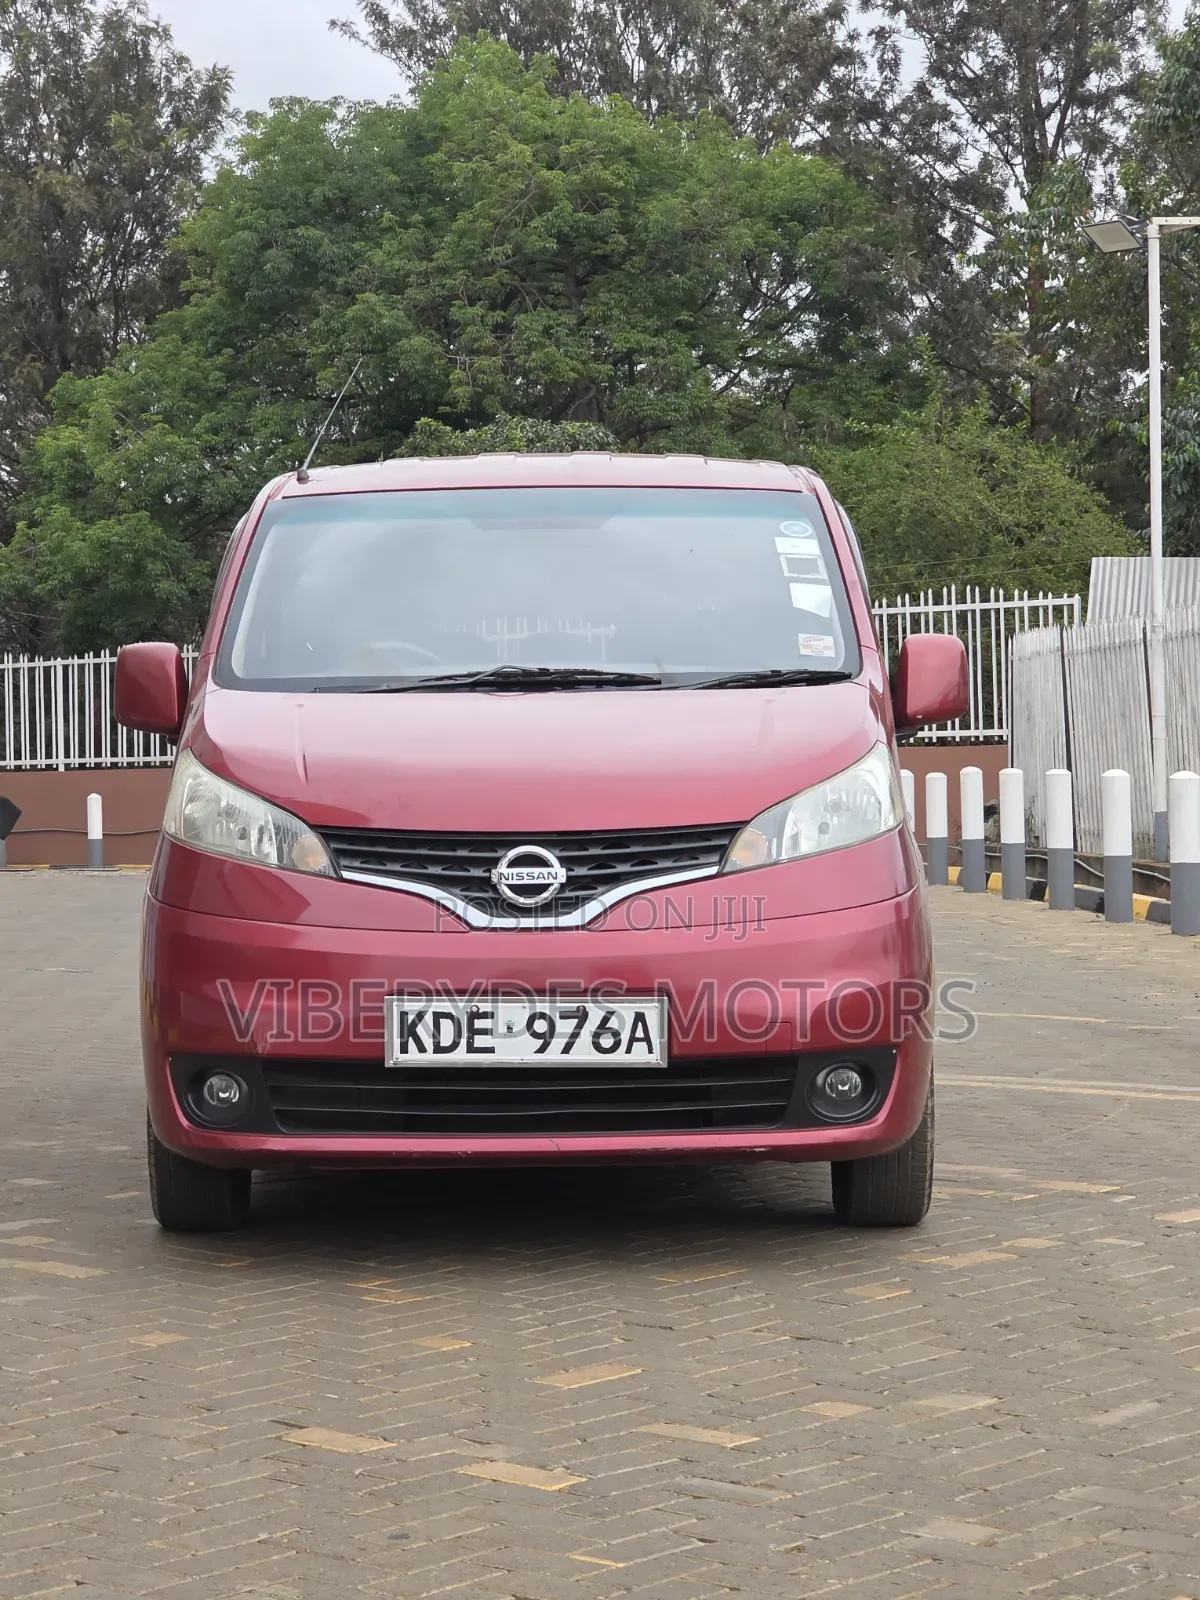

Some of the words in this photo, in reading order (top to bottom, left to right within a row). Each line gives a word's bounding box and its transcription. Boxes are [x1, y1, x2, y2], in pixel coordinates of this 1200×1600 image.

[499, 871, 558, 881] NISSAN
[400, 1010, 496, 1055] KDE
[525, 1010, 654, 1055] 976A
